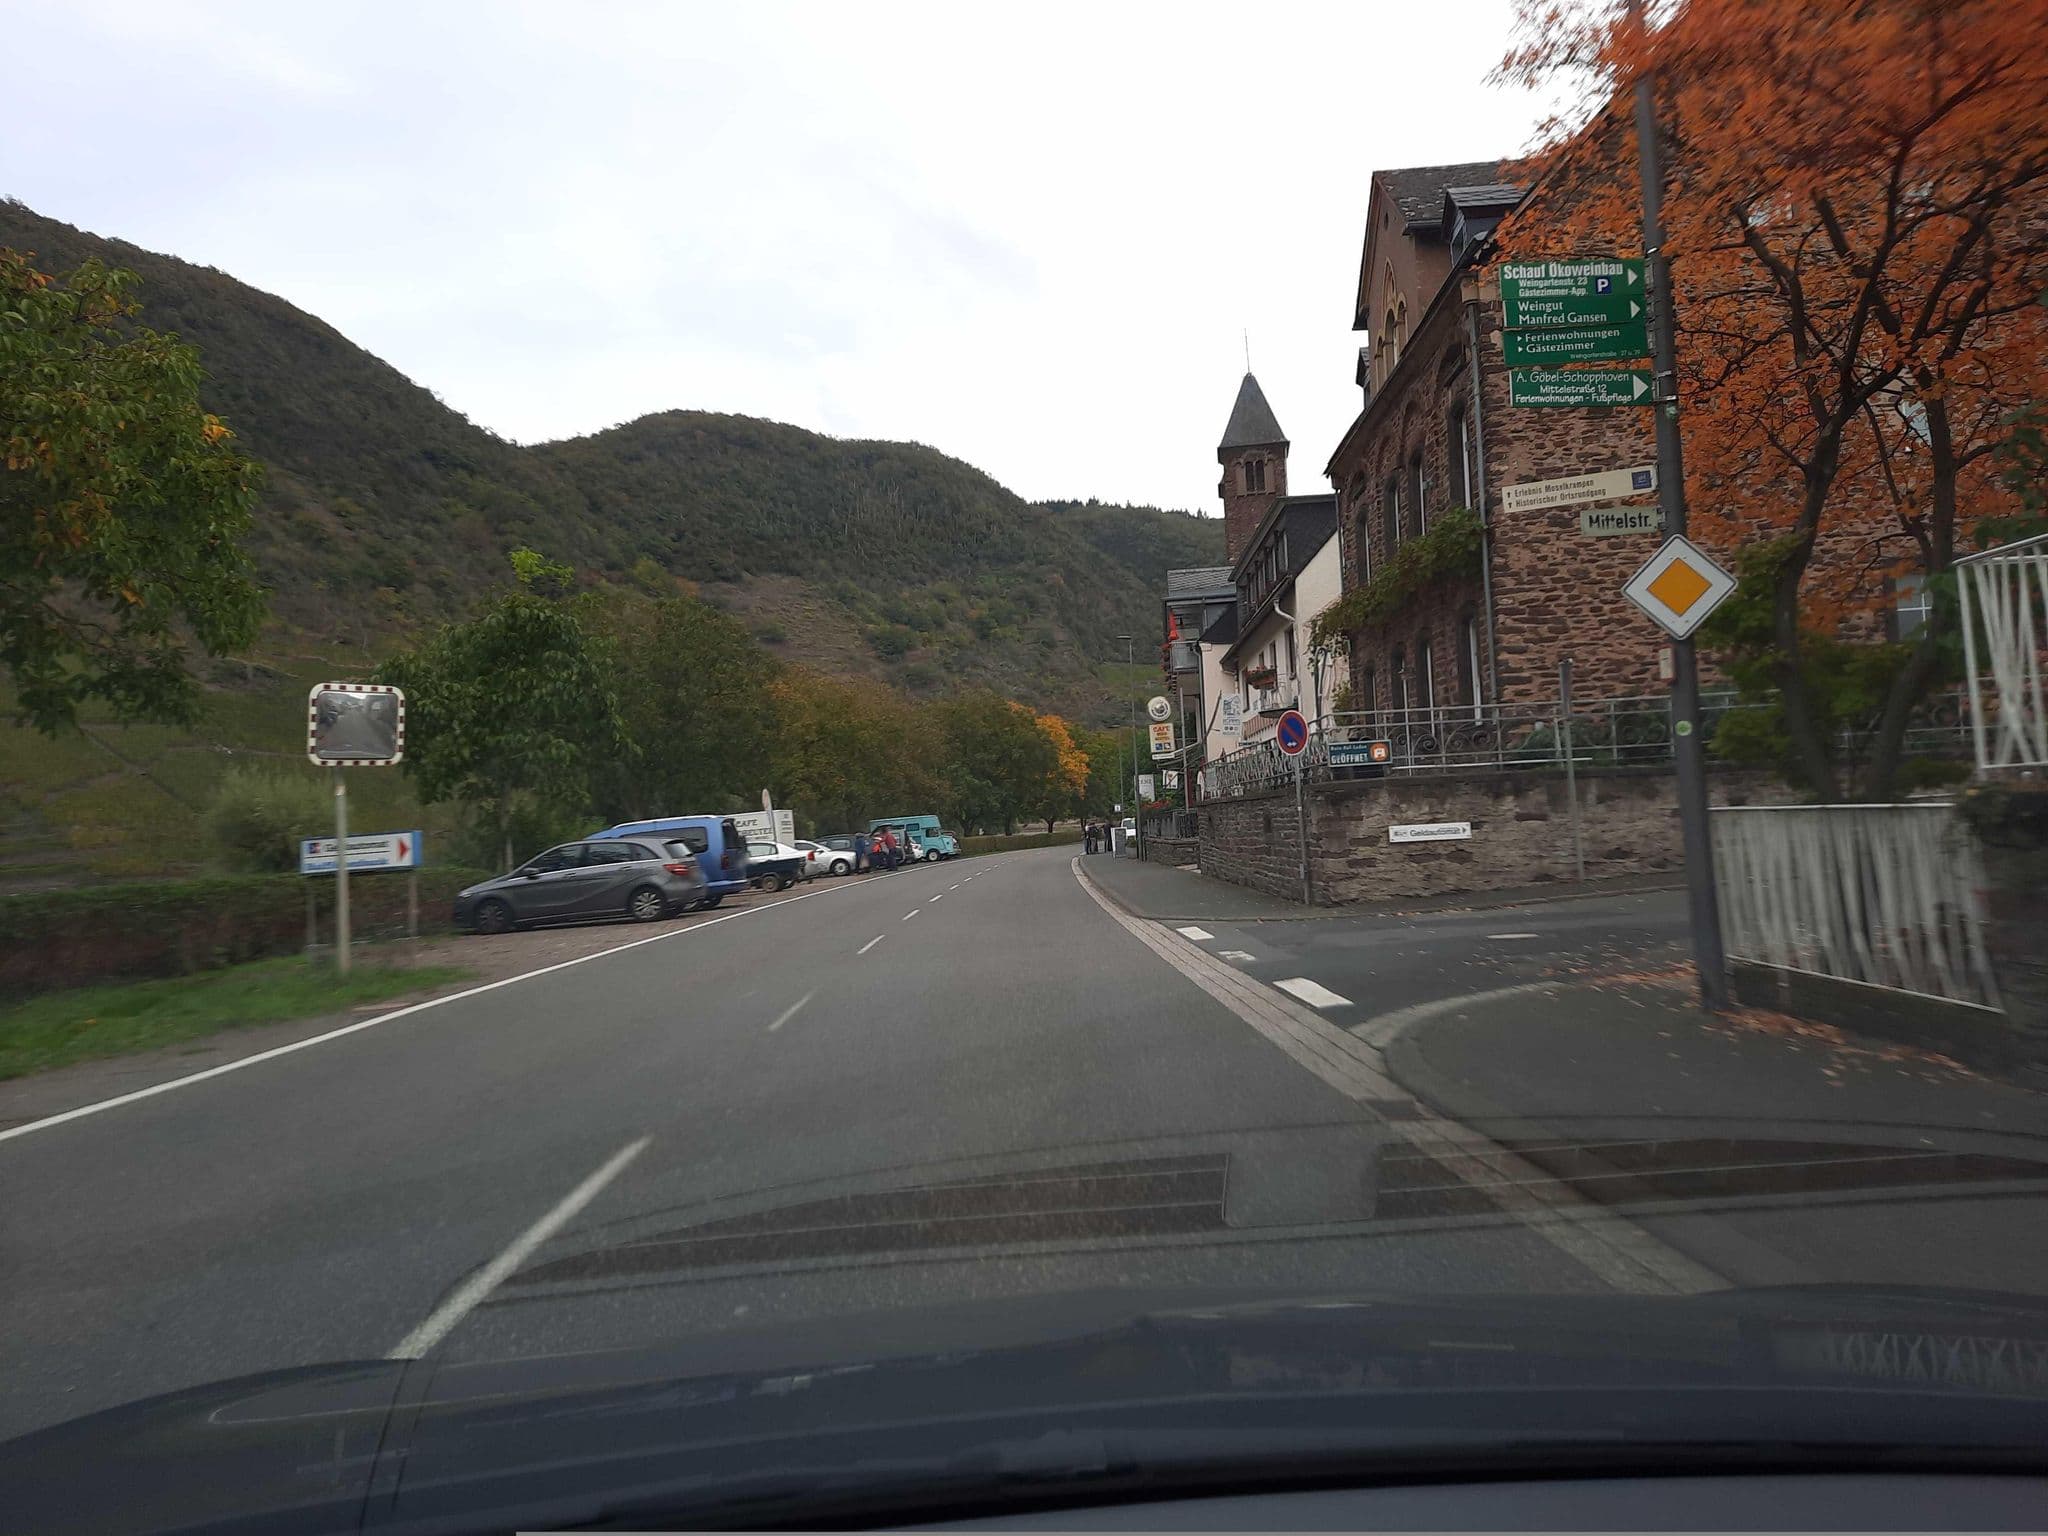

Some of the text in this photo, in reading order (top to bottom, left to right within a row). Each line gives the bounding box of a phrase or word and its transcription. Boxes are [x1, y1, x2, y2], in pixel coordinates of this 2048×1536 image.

[1503, 261, 1623, 279] Schauf Ökoweinbau
[1577, 276, 1588, 285] 23
[1597, 278, 1609, 292] P
[1518, 301, 1563, 313] Weingut
[1519, 312, 1607, 325] Manfred Gansen
[1525, 329, 1620, 342] Ferienwohnungen
[1526, 341, 1595, 353] Gästezimmer
[1516, 370, 1629, 385] A. Göbel-Schopphoven
[1540, 383, 1607, 394] Mittelstraße 12
[1515, 393, 1584, 405] Ferienwohnungen
[1592, 392, 1633, 404] Fußpflege
[1514, 487, 1542, 498] Erlebnis
[1516, 494, 1558, 508] Historischer
[1588, 512, 1652, 529] Mittelstr.
[1331, 753, 1368, 765] GEÖFFNET
